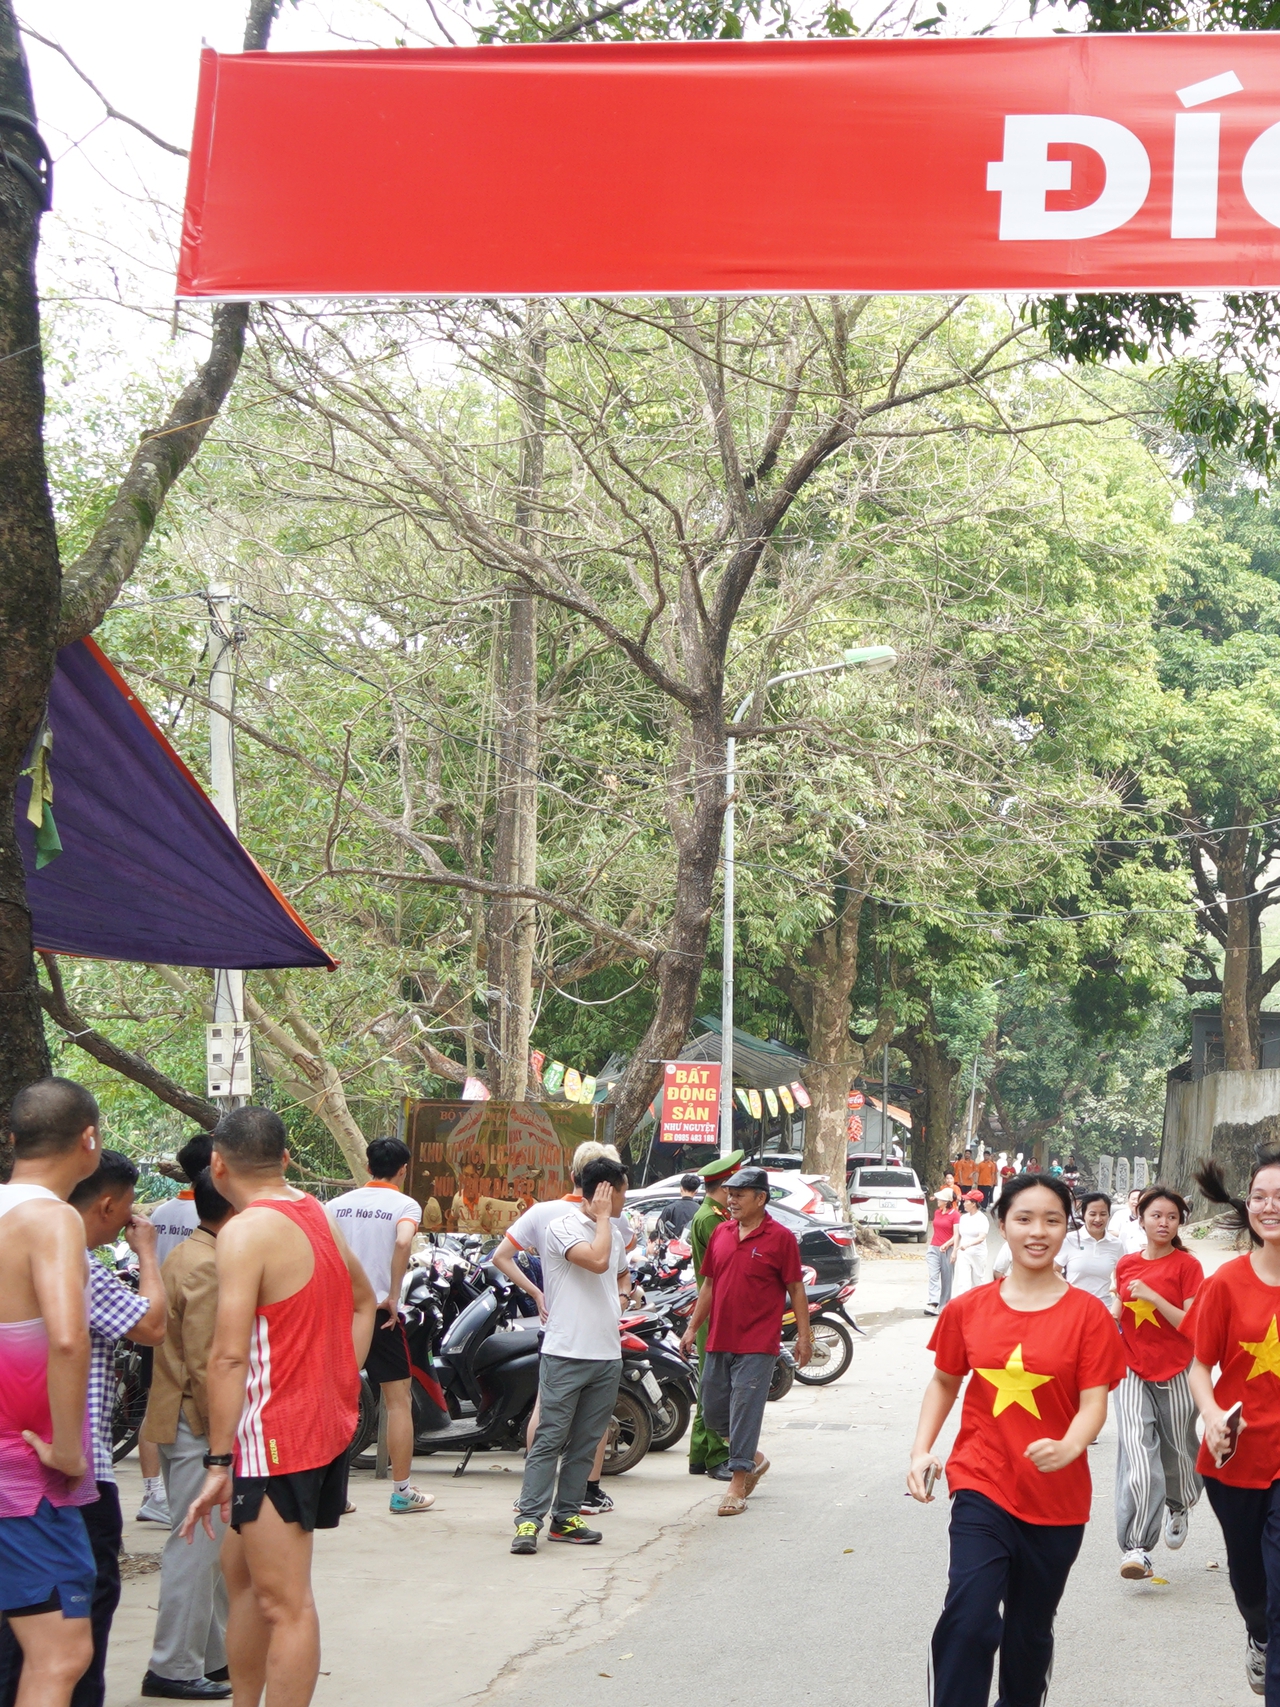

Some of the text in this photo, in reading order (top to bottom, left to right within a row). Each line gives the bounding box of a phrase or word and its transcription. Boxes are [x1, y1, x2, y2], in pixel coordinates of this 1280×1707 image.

[676, 1066, 709, 1084] BẤT
[667, 1084, 717, 1103] ĐỘNG
[672, 1103, 709, 1120] SẢN
[664, 1122, 716, 1134] NHƯ NGUYỆT
[419, 1142, 443, 1162] KHU
[336, 1208, 353, 1218] TDP.
